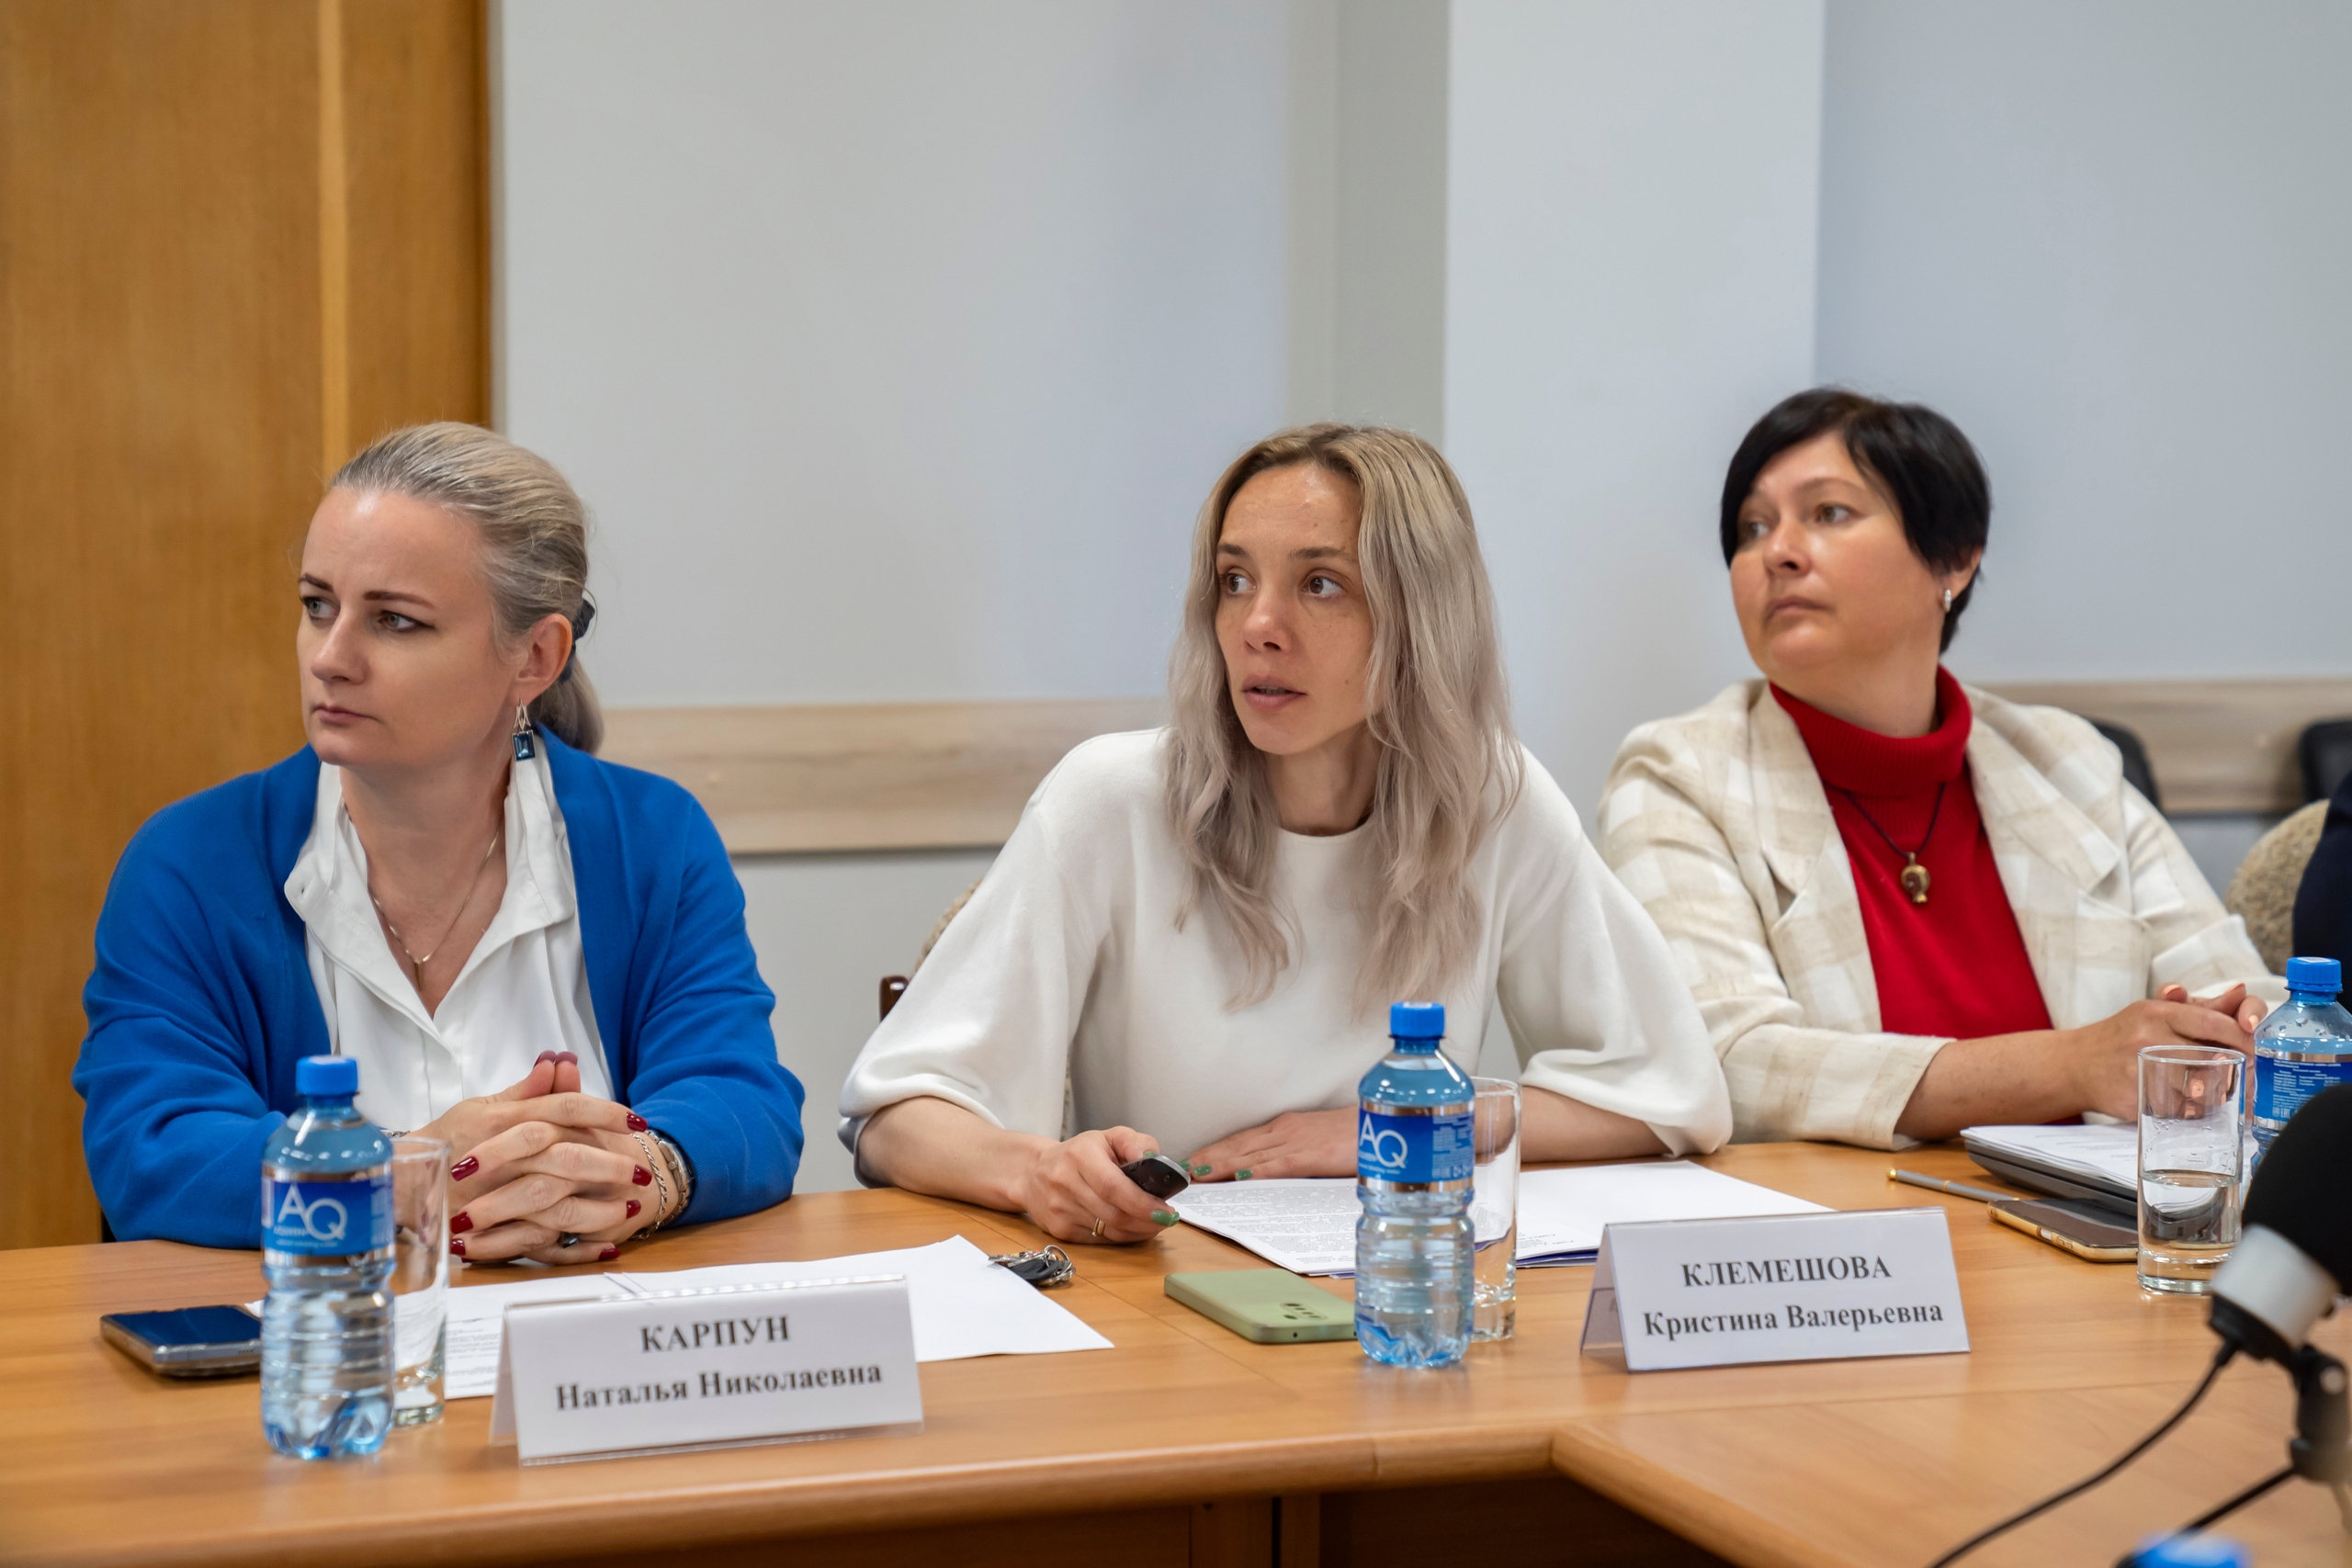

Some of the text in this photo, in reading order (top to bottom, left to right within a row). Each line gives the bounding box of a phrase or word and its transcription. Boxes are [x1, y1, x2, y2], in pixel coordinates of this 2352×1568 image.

[277, 1183, 347, 1240] AQ
[1680, 1255, 1893, 1288] КЛЕМЕШОВА
[640, 1314, 791, 1353] КАРПУН
[1643, 1303, 1944, 1341] Кристина Валерьевна
[555, 1364, 883, 1411] Наталья Николаевна
